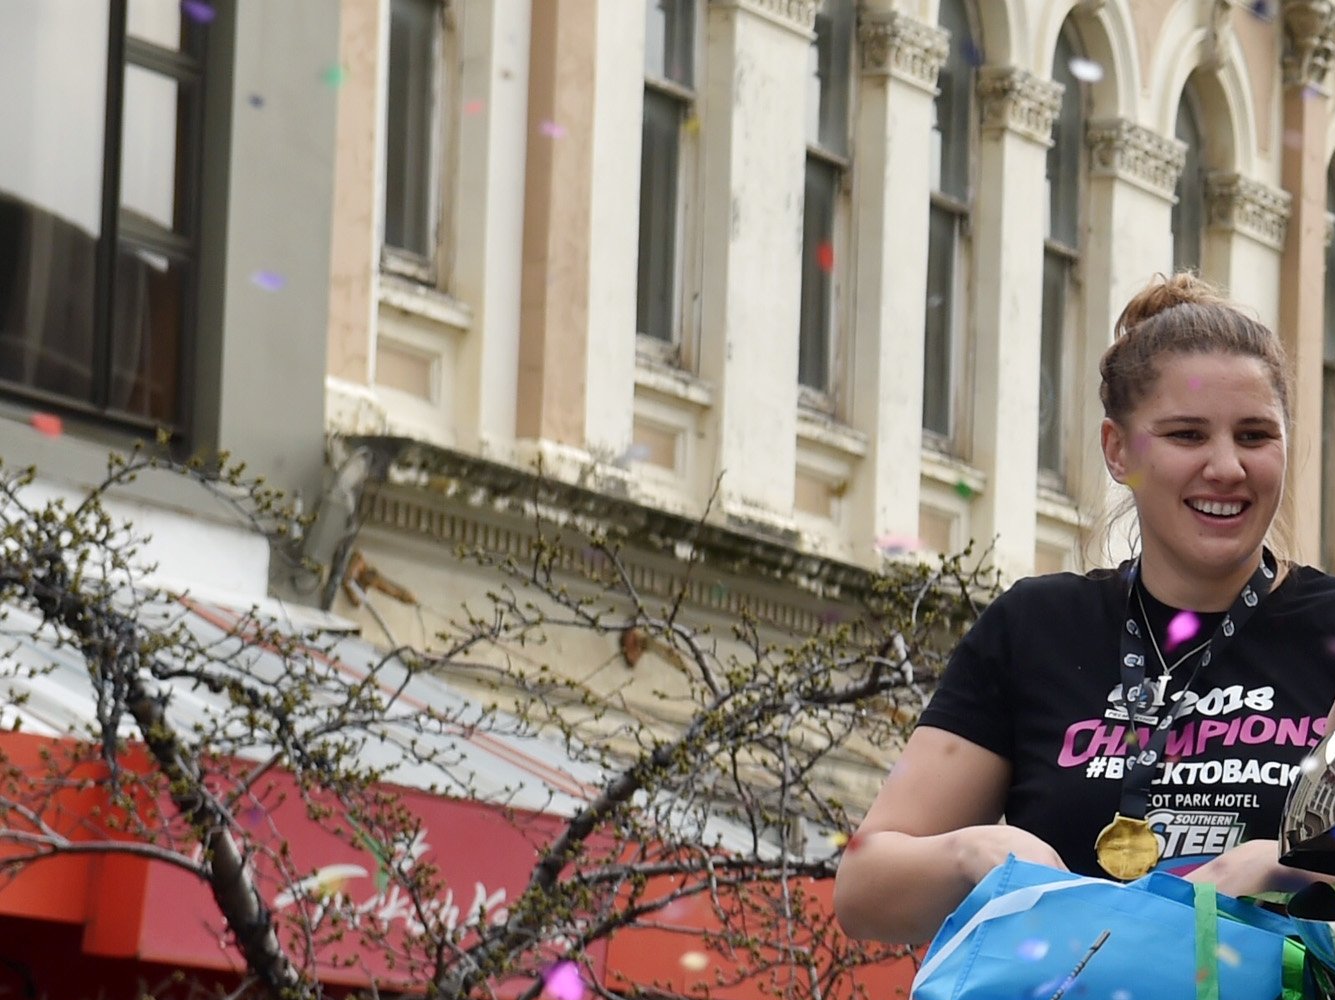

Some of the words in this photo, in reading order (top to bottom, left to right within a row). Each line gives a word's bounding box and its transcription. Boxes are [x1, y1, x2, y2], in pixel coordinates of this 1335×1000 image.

[1170, 685, 1275, 719] 2018
[1175, 794, 1210, 807] PARK
[1214, 794, 1260, 808] HOTEL
[1173, 813, 1234, 826] SOUTHERN
